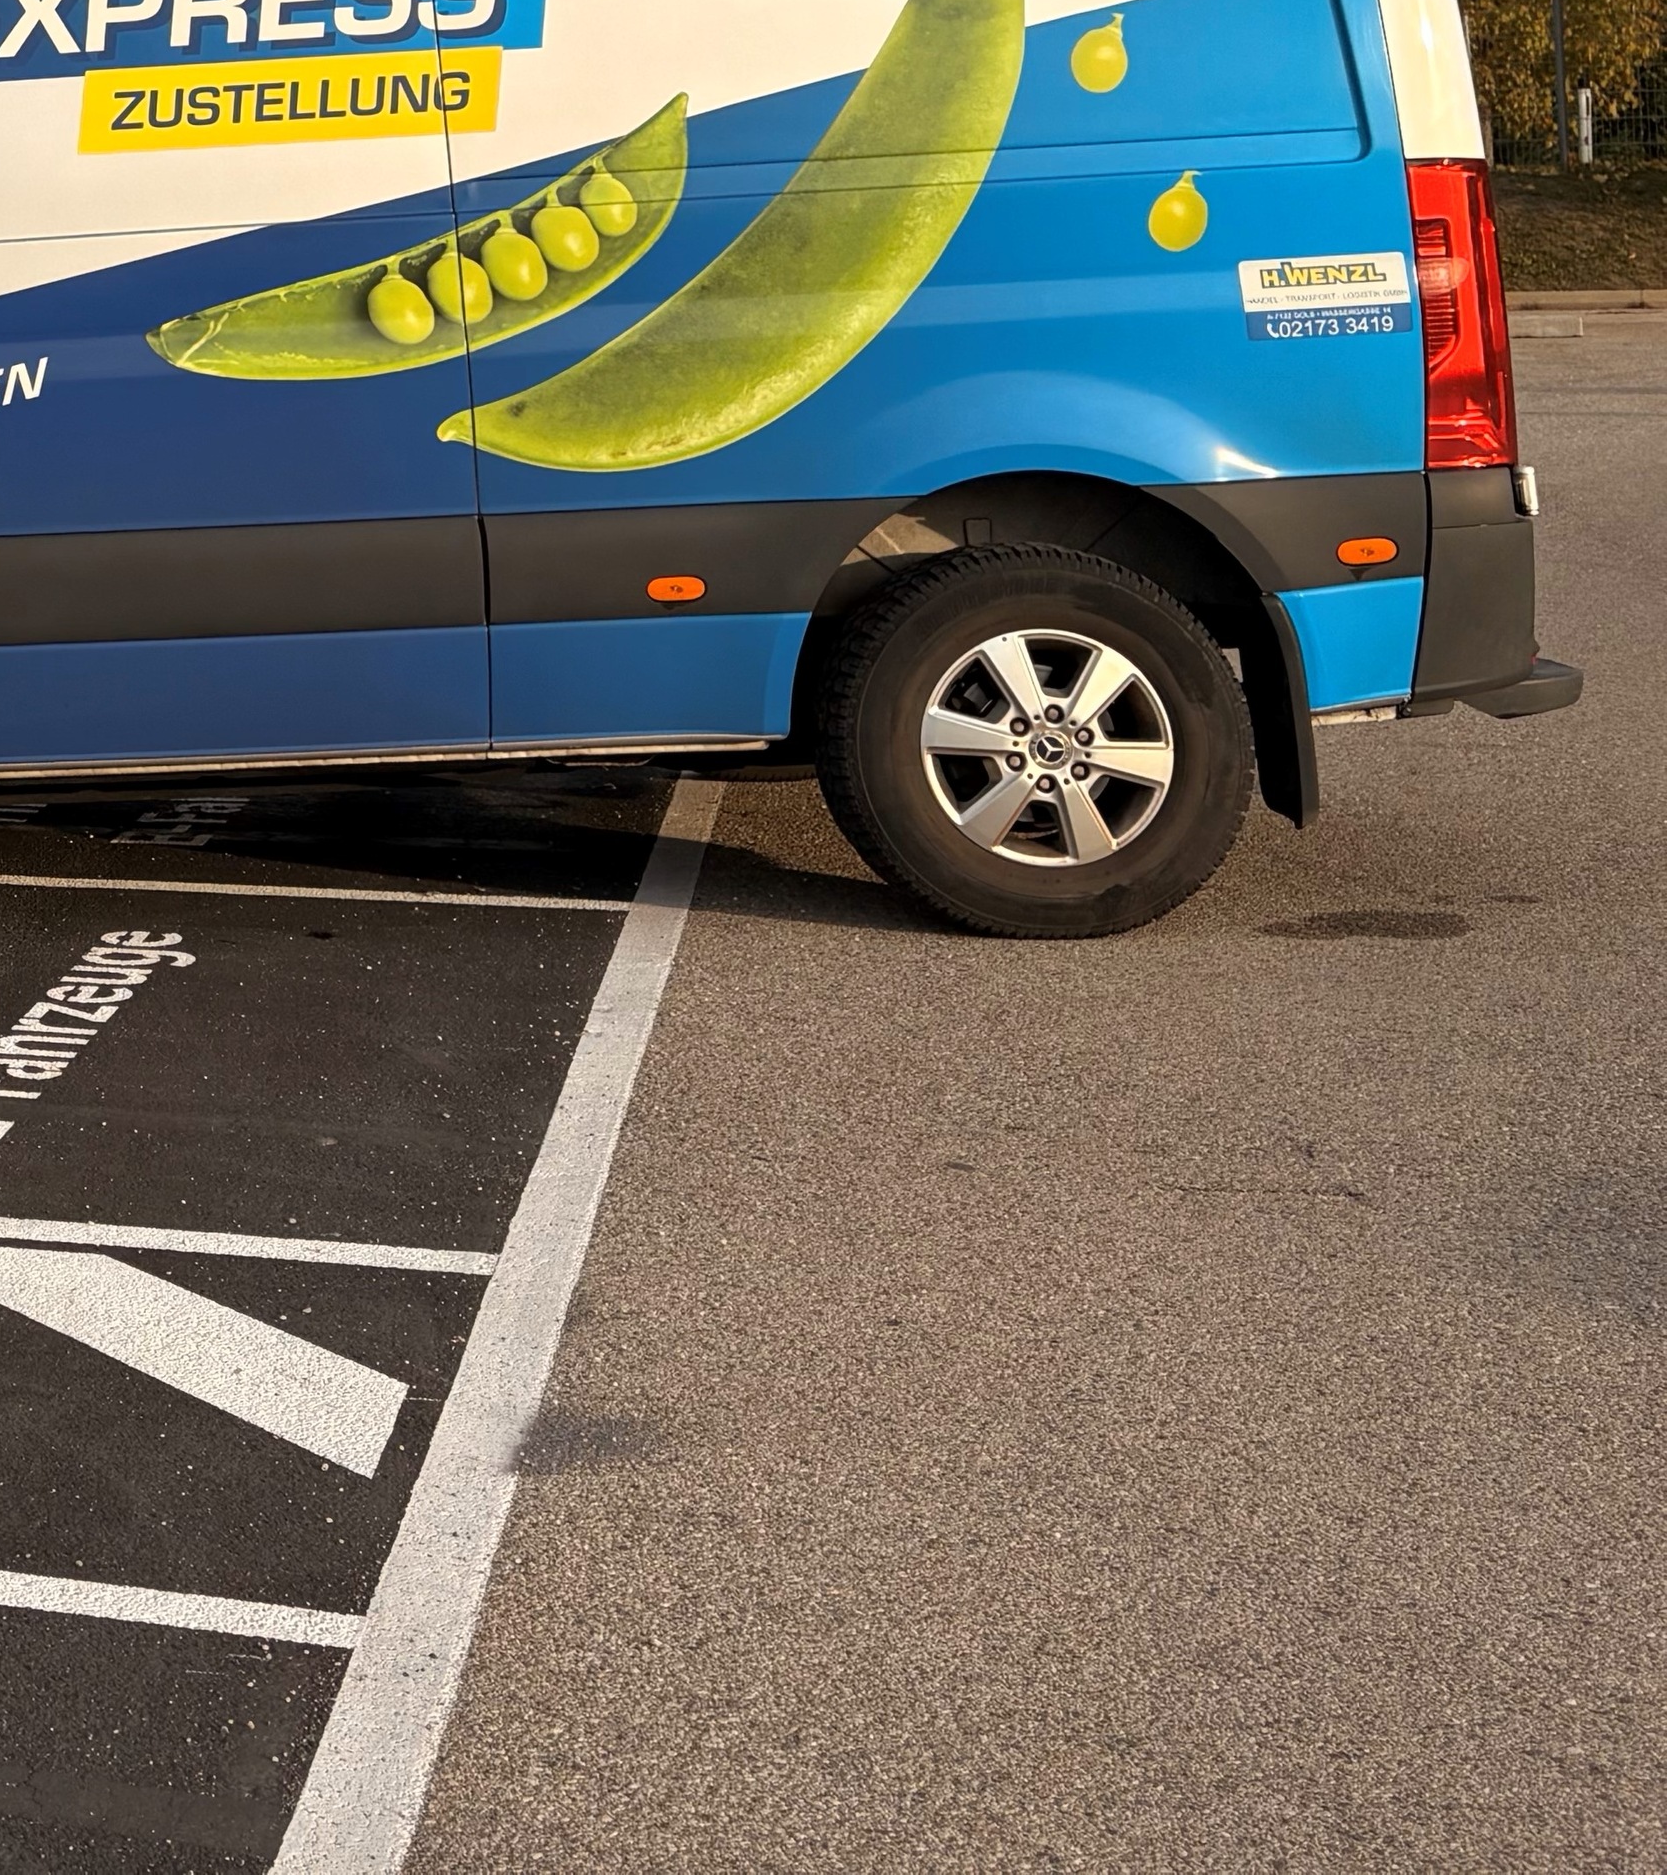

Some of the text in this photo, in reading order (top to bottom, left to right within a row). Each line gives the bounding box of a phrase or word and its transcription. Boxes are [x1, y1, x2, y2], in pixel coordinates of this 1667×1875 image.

[110, 71, 473, 131] ZUSTELLUNG
[1259, 261, 1387, 290] H.WENZL
[1278, 315, 1395, 339] 02173 3419
